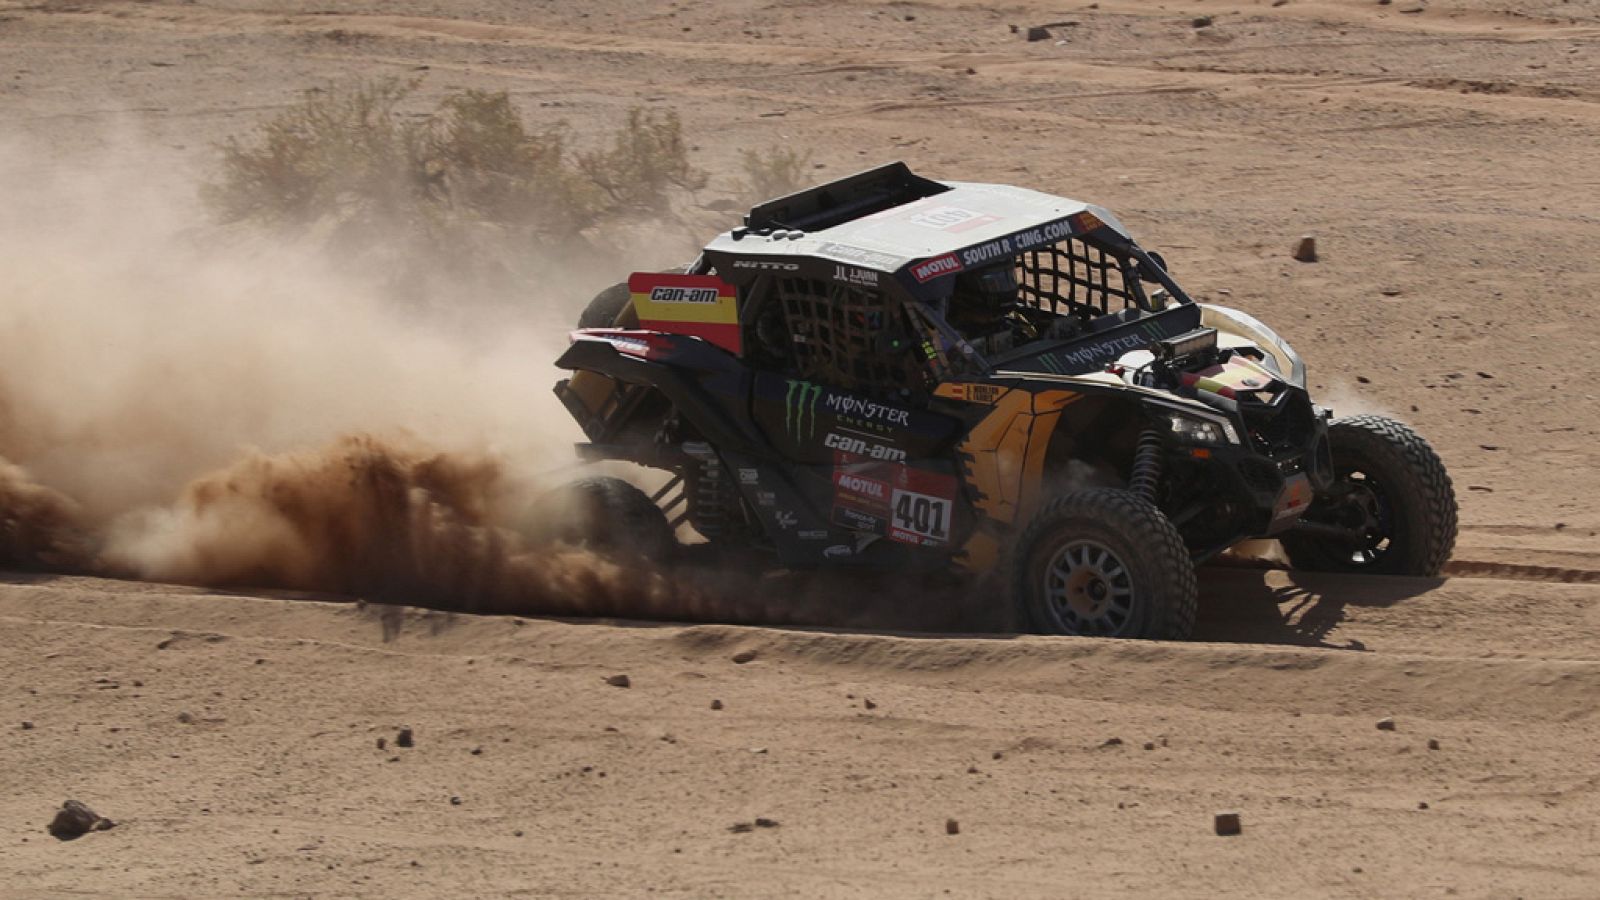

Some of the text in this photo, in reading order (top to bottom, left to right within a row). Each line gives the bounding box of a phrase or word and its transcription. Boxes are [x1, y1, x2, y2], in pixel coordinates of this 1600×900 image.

[917, 255, 959, 279] MOTUL
[963, 242, 1001, 266] SOUTH
[1000, 220, 1073, 253] RCING.COM
[733, 261, 799, 271] NITTO
[650, 286, 718, 304] can-am
[836, 414, 895, 433] ENERGY
[824, 432, 906, 463] can-am
[838, 474, 884, 498] MOTUL
[896, 494, 946, 537] 401
